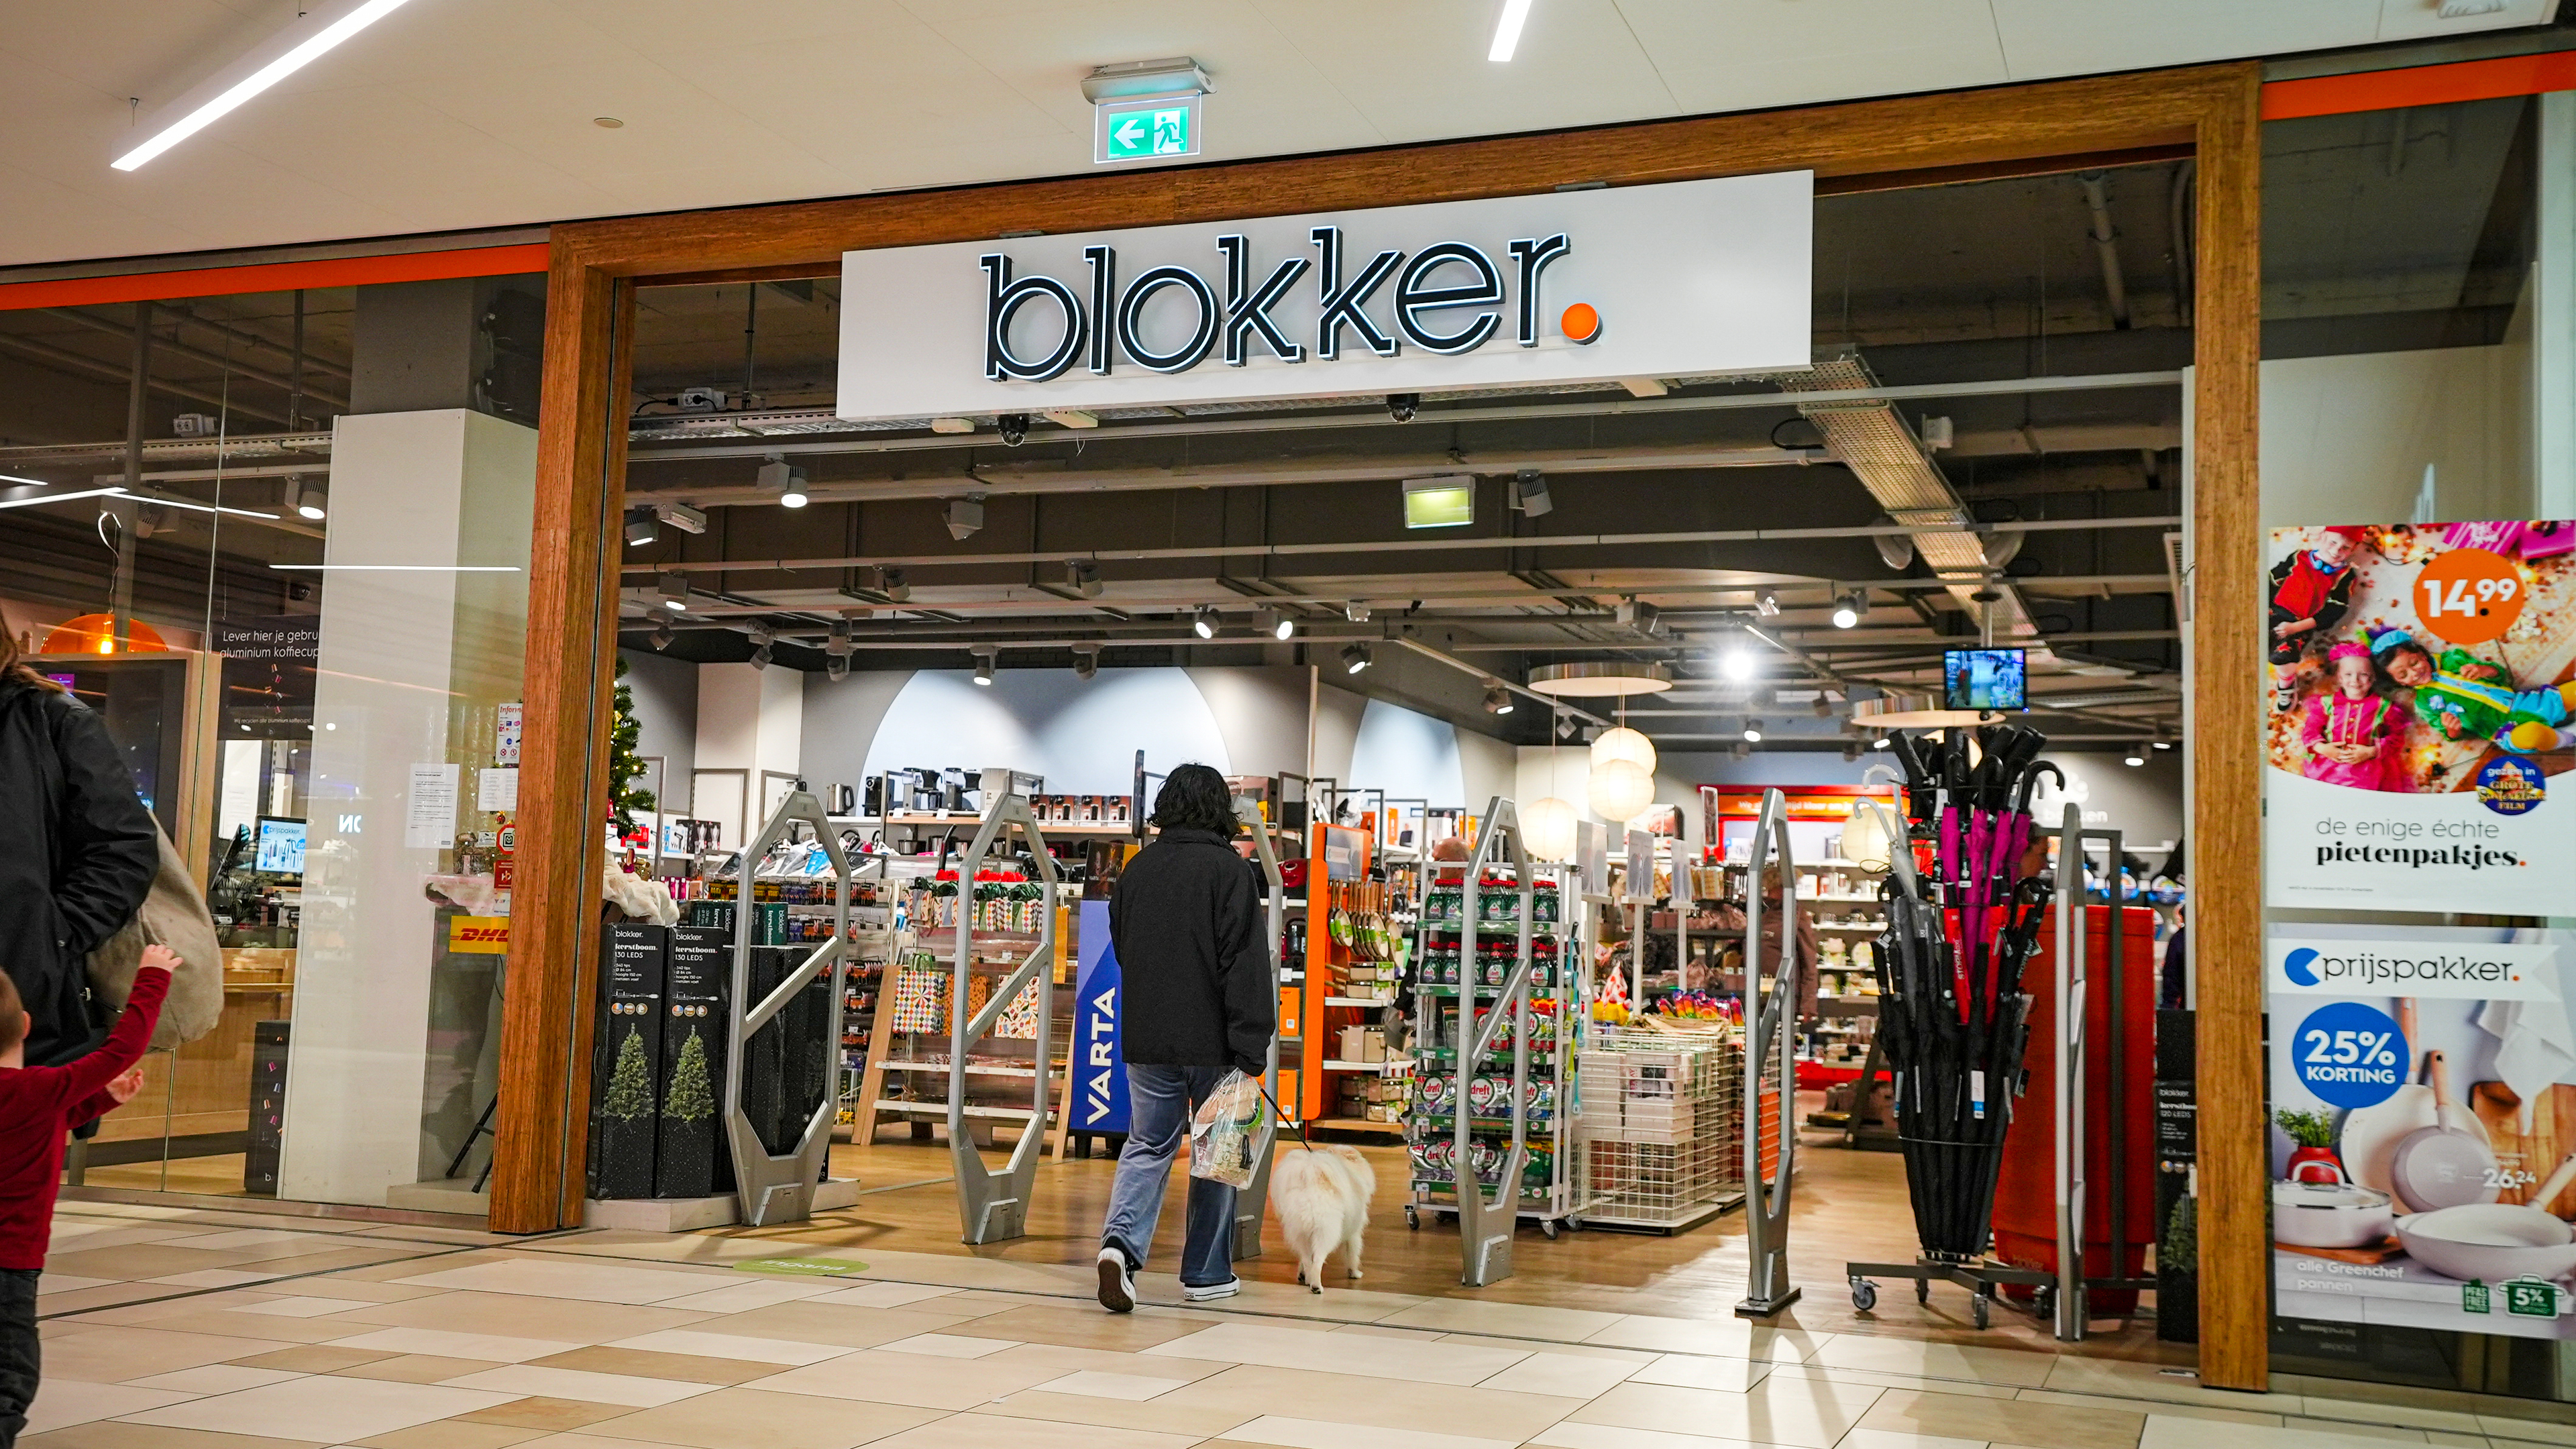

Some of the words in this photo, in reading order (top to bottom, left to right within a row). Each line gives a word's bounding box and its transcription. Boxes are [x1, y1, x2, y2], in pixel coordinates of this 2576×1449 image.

[979, 225, 1603, 383] blokker.
[223, 631, 251, 641] Lever
[254, 630, 273, 641] hier
[274, 629, 284, 643] je
[287, 629, 319, 643] gebru
[219, 647, 271, 658] aluminium
[274, 645, 319, 659] koffiecup
[2487, 768, 2524, 777] gezien
[2525, 767, 2536, 775] in
[2316, 817, 2347, 835] de
[2356, 818, 2423, 841] enige
[2432, 818, 2500, 839] échte
[2316, 841, 2526, 871] pietenpakjes.
[2322, 953, 2520, 985] prijspakker.
[1087, 987, 1116, 1125] VARTA
[2304, 1029, 2397, 1066] 25%
[2306, 1066, 2396, 1085] KORTING
[1425, 1083, 1441, 1093] dreft
[1470, 1084, 1491, 1095] dreft
[2173, 1110, 2192, 1118] LEDS
[2297, 1260, 2324, 1273] alle
[2327, 1261, 2405, 1279] Greenchef
[2298, 1279, 2353, 1292] pannen
[2514, 1287, 2545, 1306] 5%
